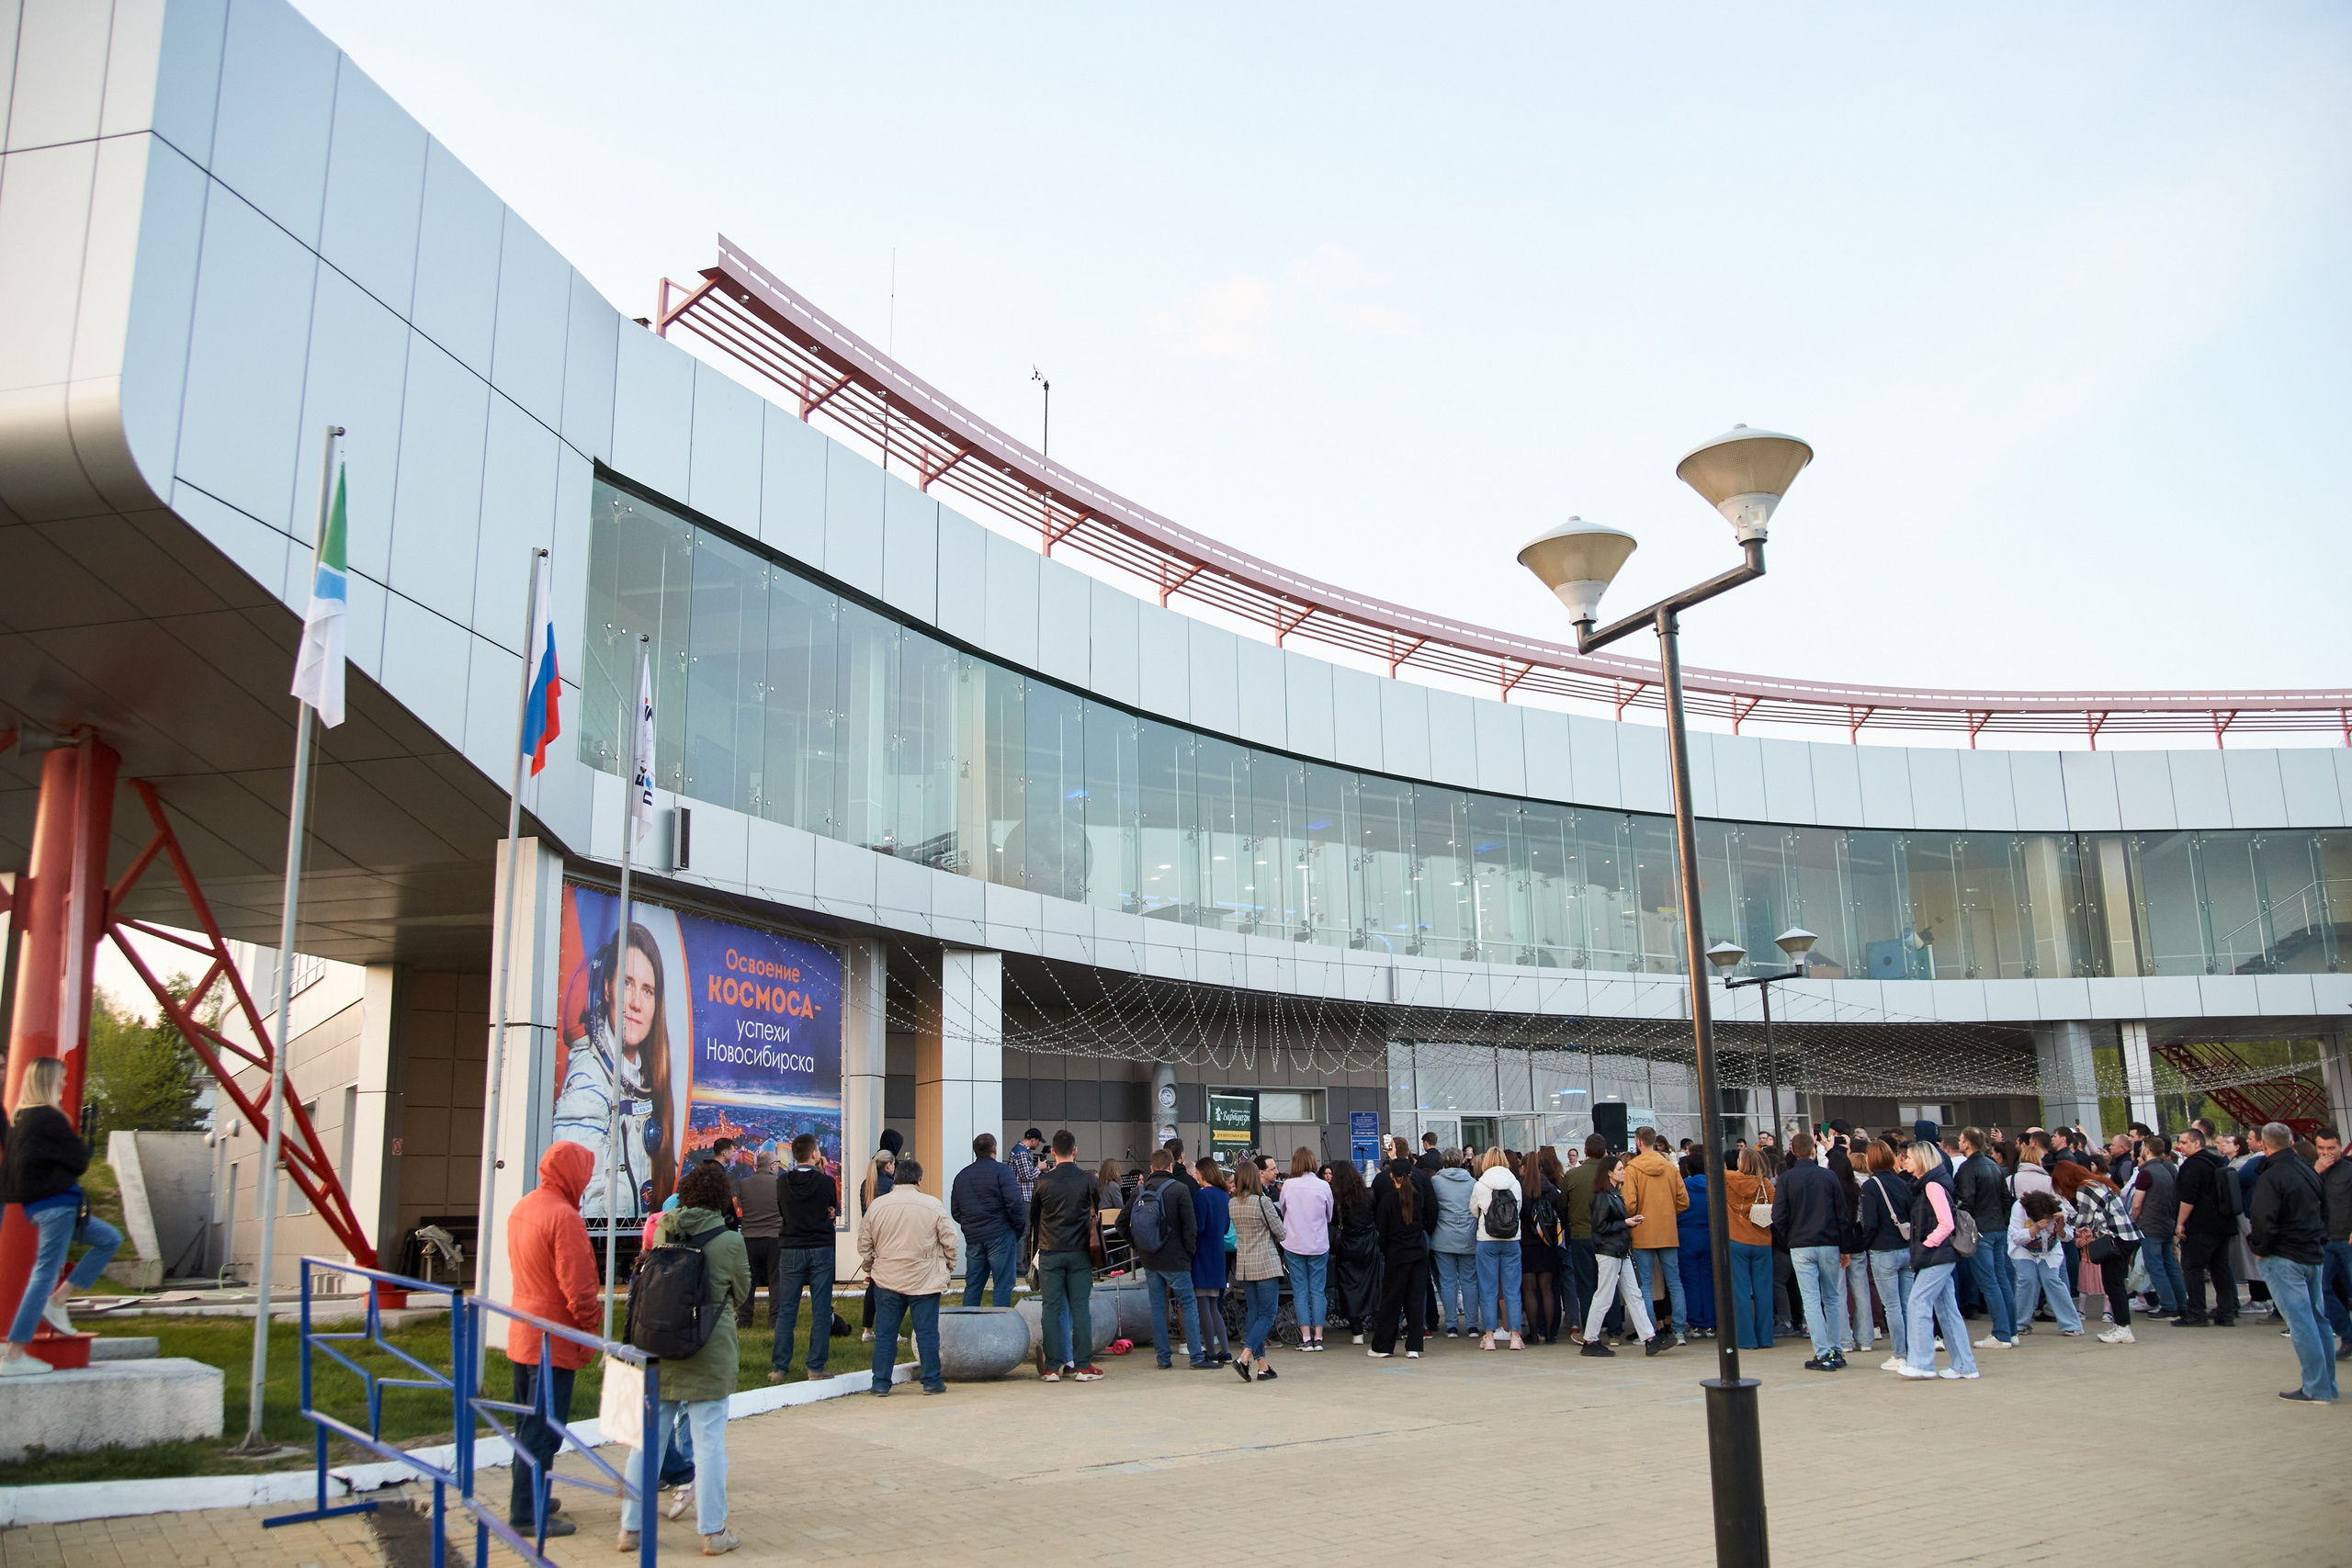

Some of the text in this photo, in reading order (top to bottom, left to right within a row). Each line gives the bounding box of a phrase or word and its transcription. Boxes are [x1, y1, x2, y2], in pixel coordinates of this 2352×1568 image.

[726, 948, 800, 984] Освоение
[736, 1019, 790, 1043] успехи
[707, 1037, 814, 1074] Новосибирска
